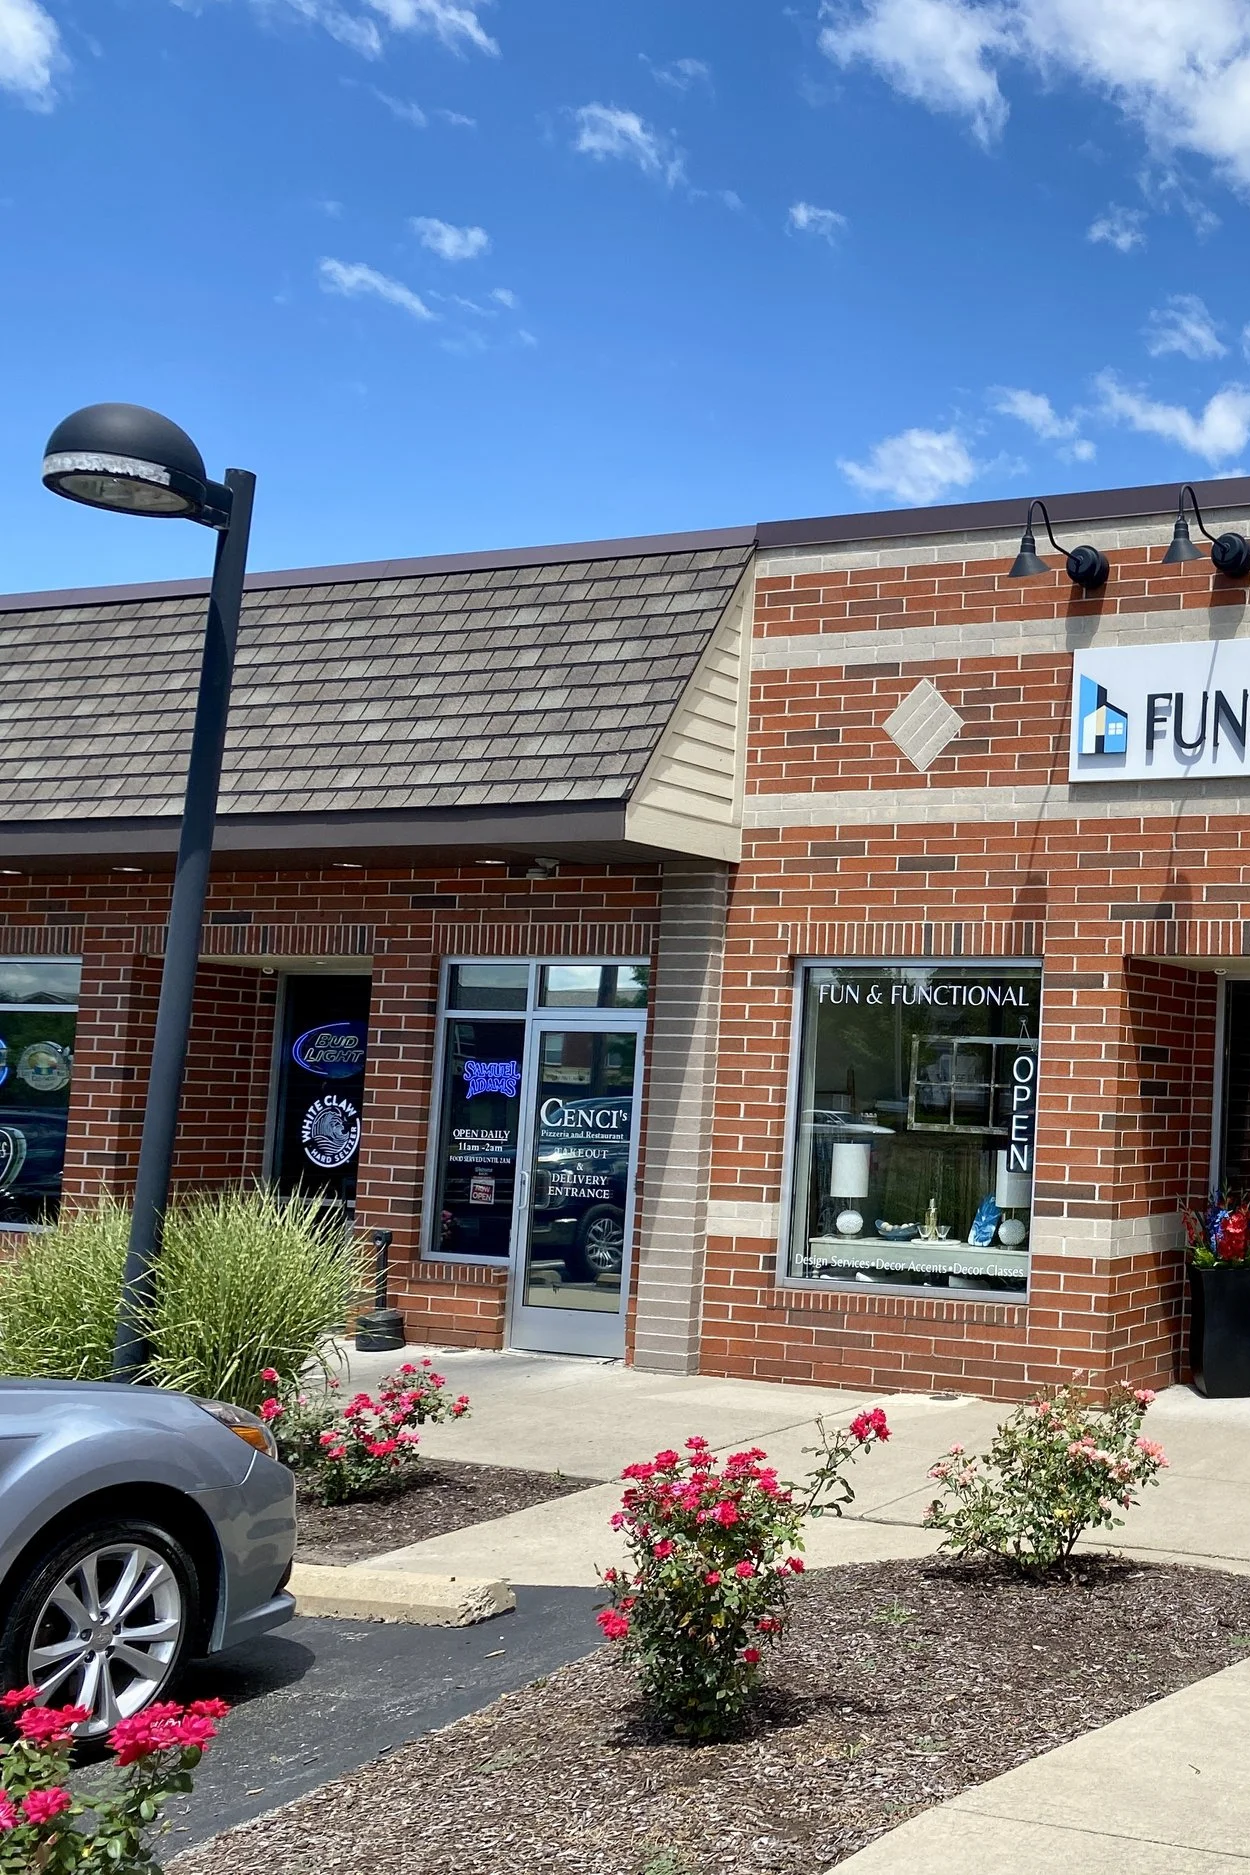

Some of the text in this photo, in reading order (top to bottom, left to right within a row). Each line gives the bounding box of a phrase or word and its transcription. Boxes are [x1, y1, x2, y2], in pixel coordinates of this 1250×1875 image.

[819, 984, 1030, 1007] FUN & FUNCTIONAL
[315, 1033, 359, 1048] BUD
[304, 1048, 364, 1062] LIGHT
[463, 1060, 521, 1080] SAMUEL
[466, 1077, 517, 1099] ADAMS
[302, 1094, 357, 1143] WHITE CLAW
[540, 1097, 628, 1129] CENCI's
[1009, 1055, 1034, 1171] OPEN
[453, 1129, 510, 1139] OPEN DAILY
[541, 1129, 624, 1140] Pizzeria and Restaurant
[310, 1126, 357, 1163] HARD SELTZER
[458, 1142, 479, 1151] 11am
[576, 1162, 584, 1171] &
[552, 1173, 608, 1185] DELIVERY
[548, 1186, 610, 1199] ENTRANCE
[795, 1253, 1024, 1277] Design Services Decor Accents Decor Classes
